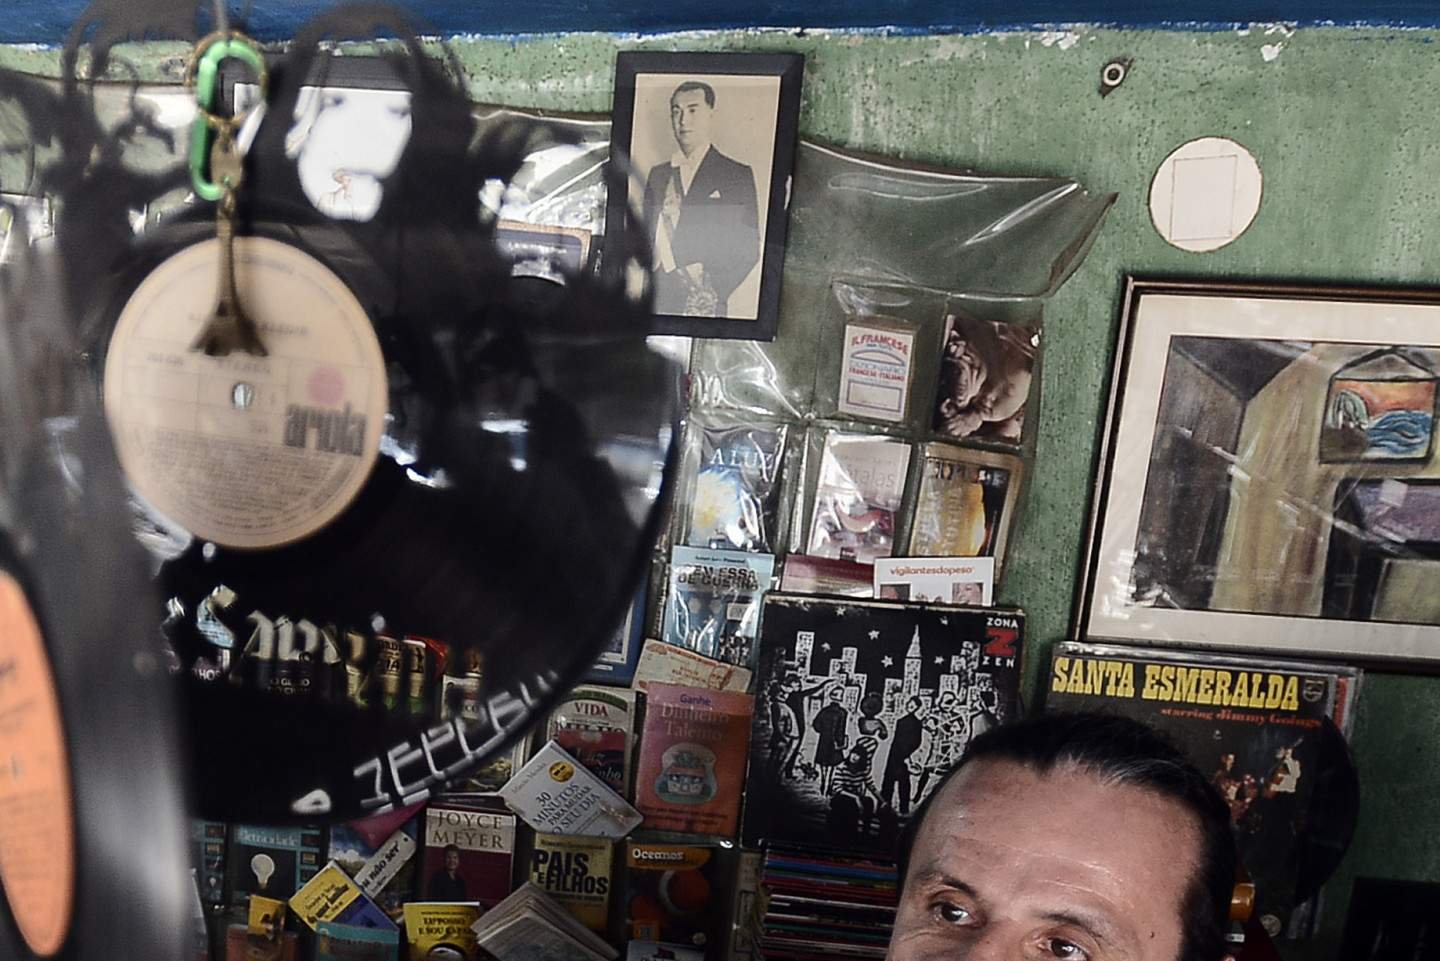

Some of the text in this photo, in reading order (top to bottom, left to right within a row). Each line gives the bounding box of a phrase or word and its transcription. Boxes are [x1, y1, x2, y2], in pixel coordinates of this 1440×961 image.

[987, 618, 1018, 629] ZONA
[982, 658, 1015, 668] ZEN
[1051, 657, 1300, 712] SANTA ESMERALDA
[574, 702, 609, 717] VIDA
[532, 782, 580, 827] MINUTOS
[536, 790, 552, 808] 30
[436, 811, 503, 830] JOYCE
[432, 830, 505, 849] MEYER
[531, 848, 589, 876] PAIS
[632, 847, 685, 861] Oceanos
[545, 873, 609, 895] FILHOS
